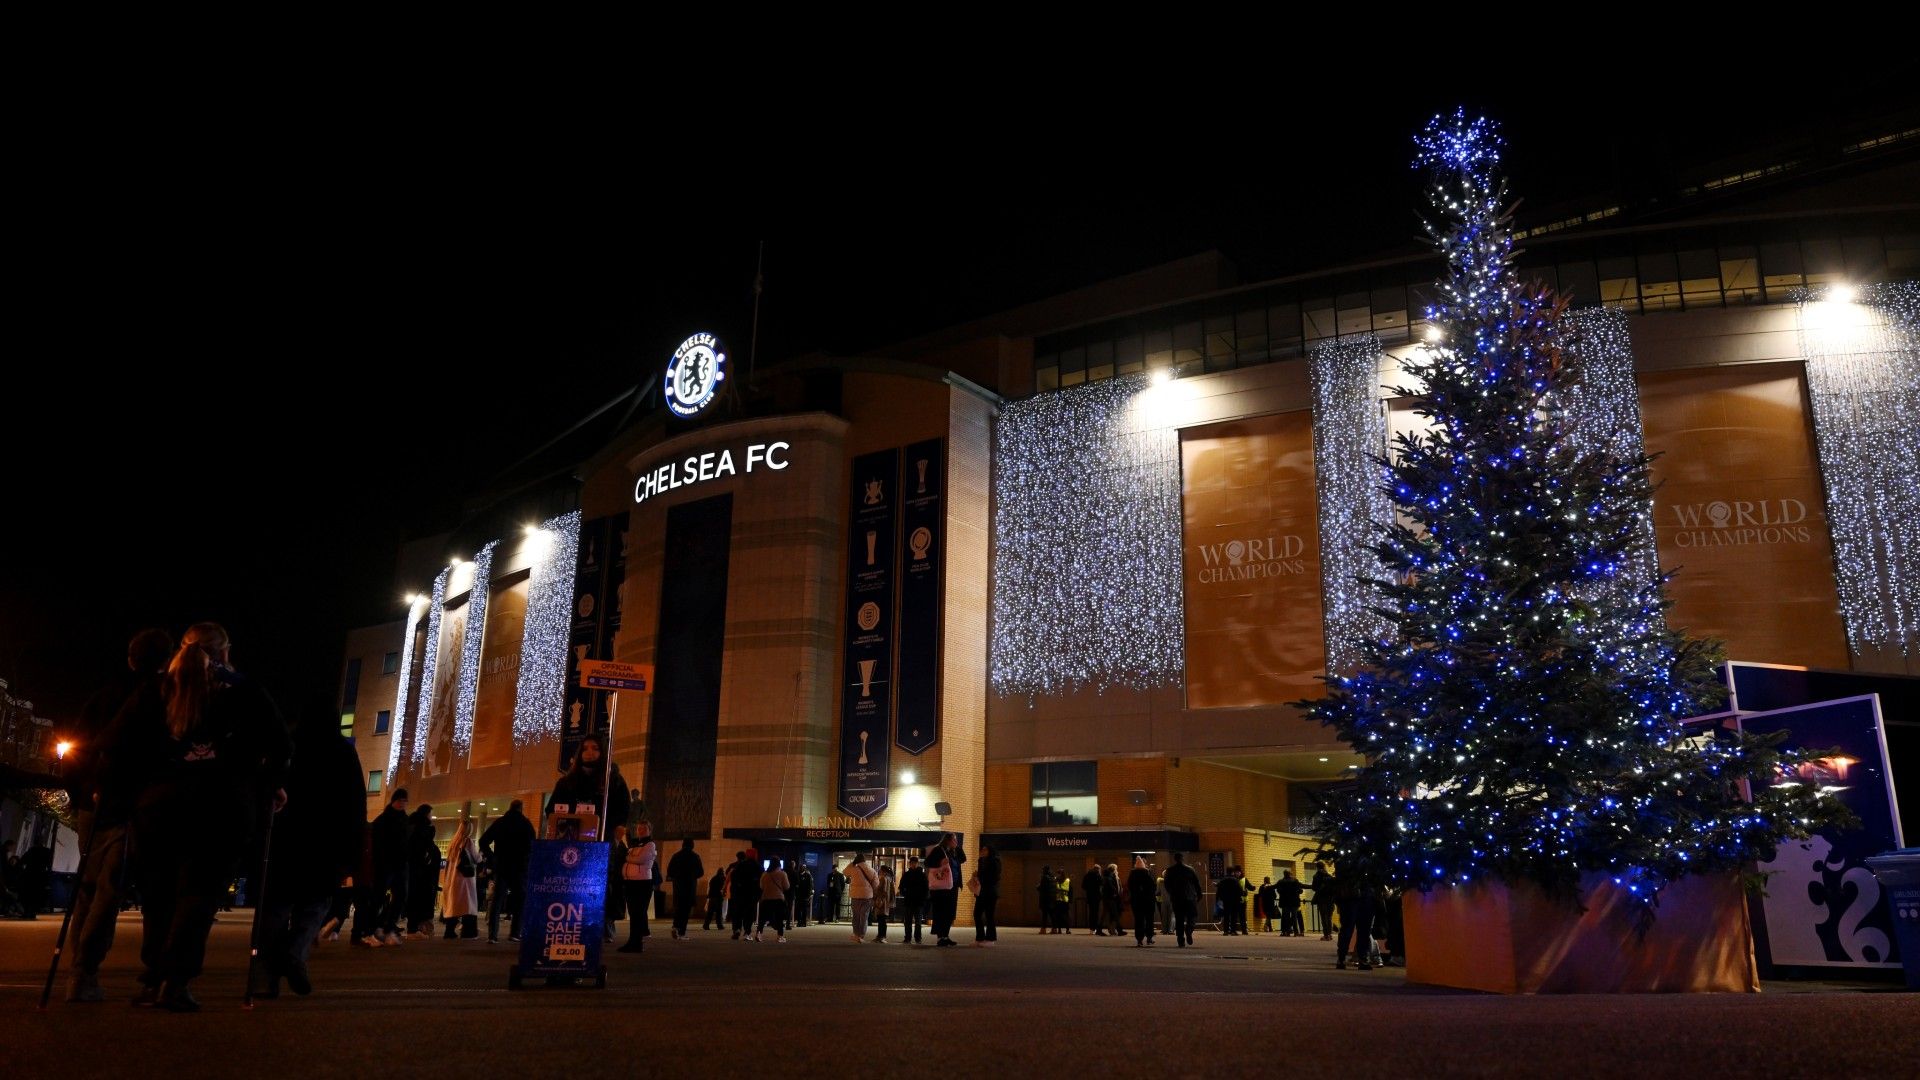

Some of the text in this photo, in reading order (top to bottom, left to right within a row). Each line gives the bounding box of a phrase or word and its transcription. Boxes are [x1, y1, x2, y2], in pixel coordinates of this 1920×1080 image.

[675, 333, 716, 358] CHELSEA
[634, 441, 790, 503] CHELSEA FC
[1672, 499, 1807, 529] WORLD
[1674, 526, 1811, 548] CHAMPIONS
[1198, 535, 1304, 567] WORLD
[1198, 559, 1305, 584] CHAMPIONS
[592, 668, 644, 679] PROGRAMMES
[601, 663, 634, 671] OFFICIAL
[783, 815, 875, 829] MILLENNIUM
[806, 830, 850, 838] RECEPTION
[1046, 836, 1088, 846] Westview
[547, 902, 584, 921] ON
[547, 921, 583, 934] SALE
[545, 933, 581, 945] HERE
[556, 948, 581, 956] £2.00
